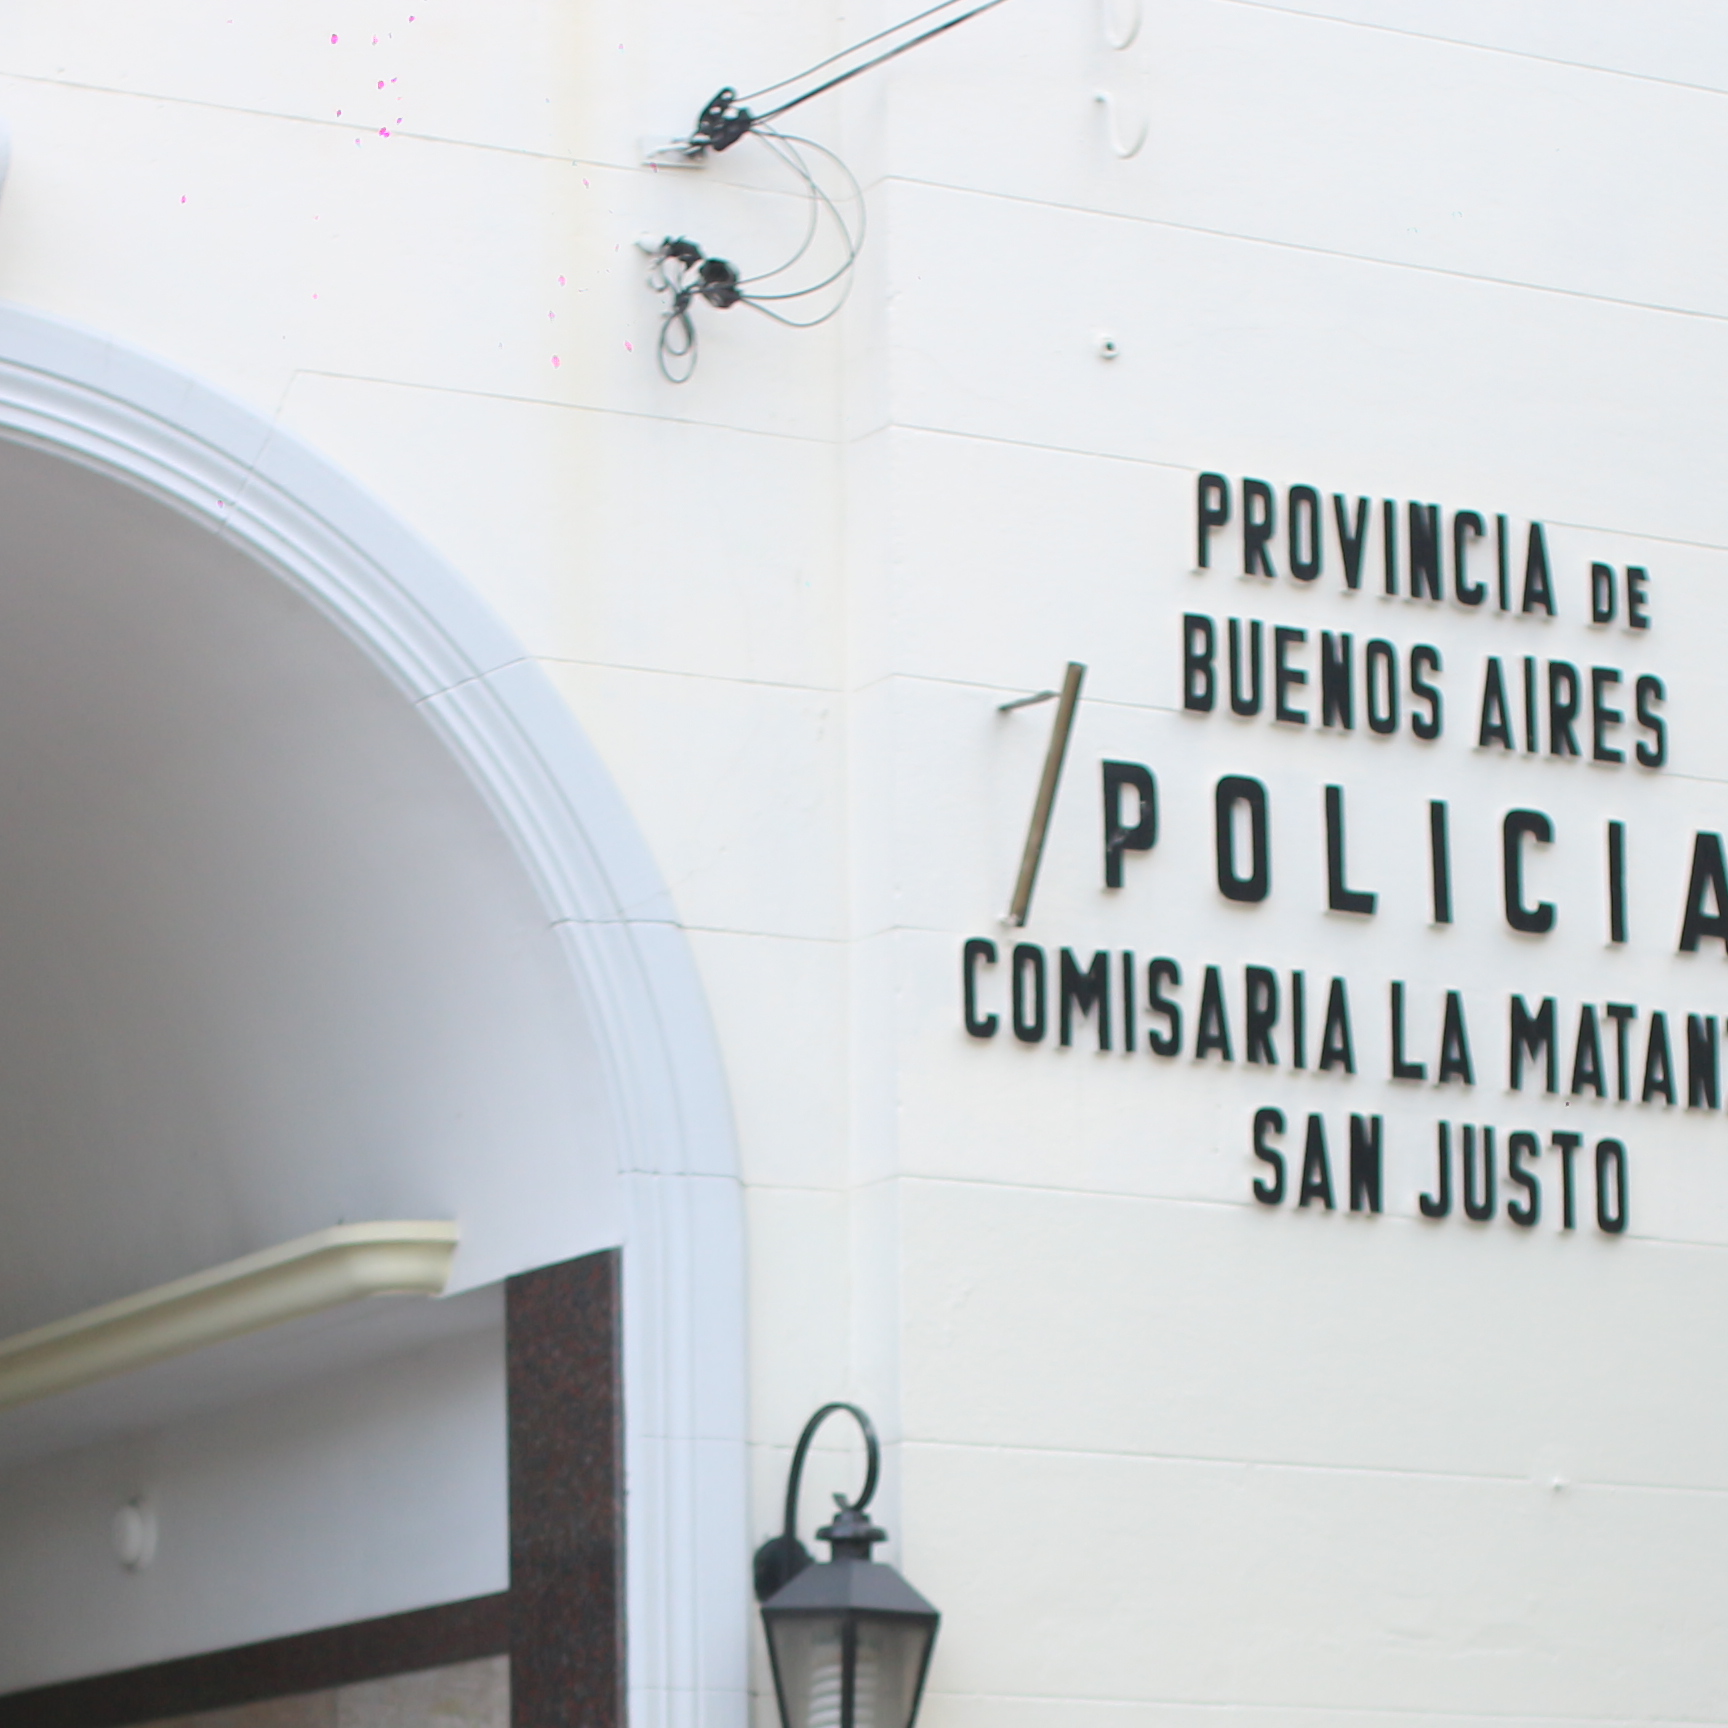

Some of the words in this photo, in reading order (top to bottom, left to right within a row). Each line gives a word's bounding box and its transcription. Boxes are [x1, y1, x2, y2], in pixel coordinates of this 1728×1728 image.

[1197, 472, 1556, 617] PROVINCIA
[1590, 562, 1652, 630] DE
[1182, 613, 1443, 742] BUENOS
[1478, 656, 1668, 770] AIRES
[962, 937, 1356, 1075] COMISARIA
[1390, 981, 1475, 1087] LA
[1252, 1106, 1384, 1215] SAN
[1419, 1120, 1629, 1236] JUSTO
